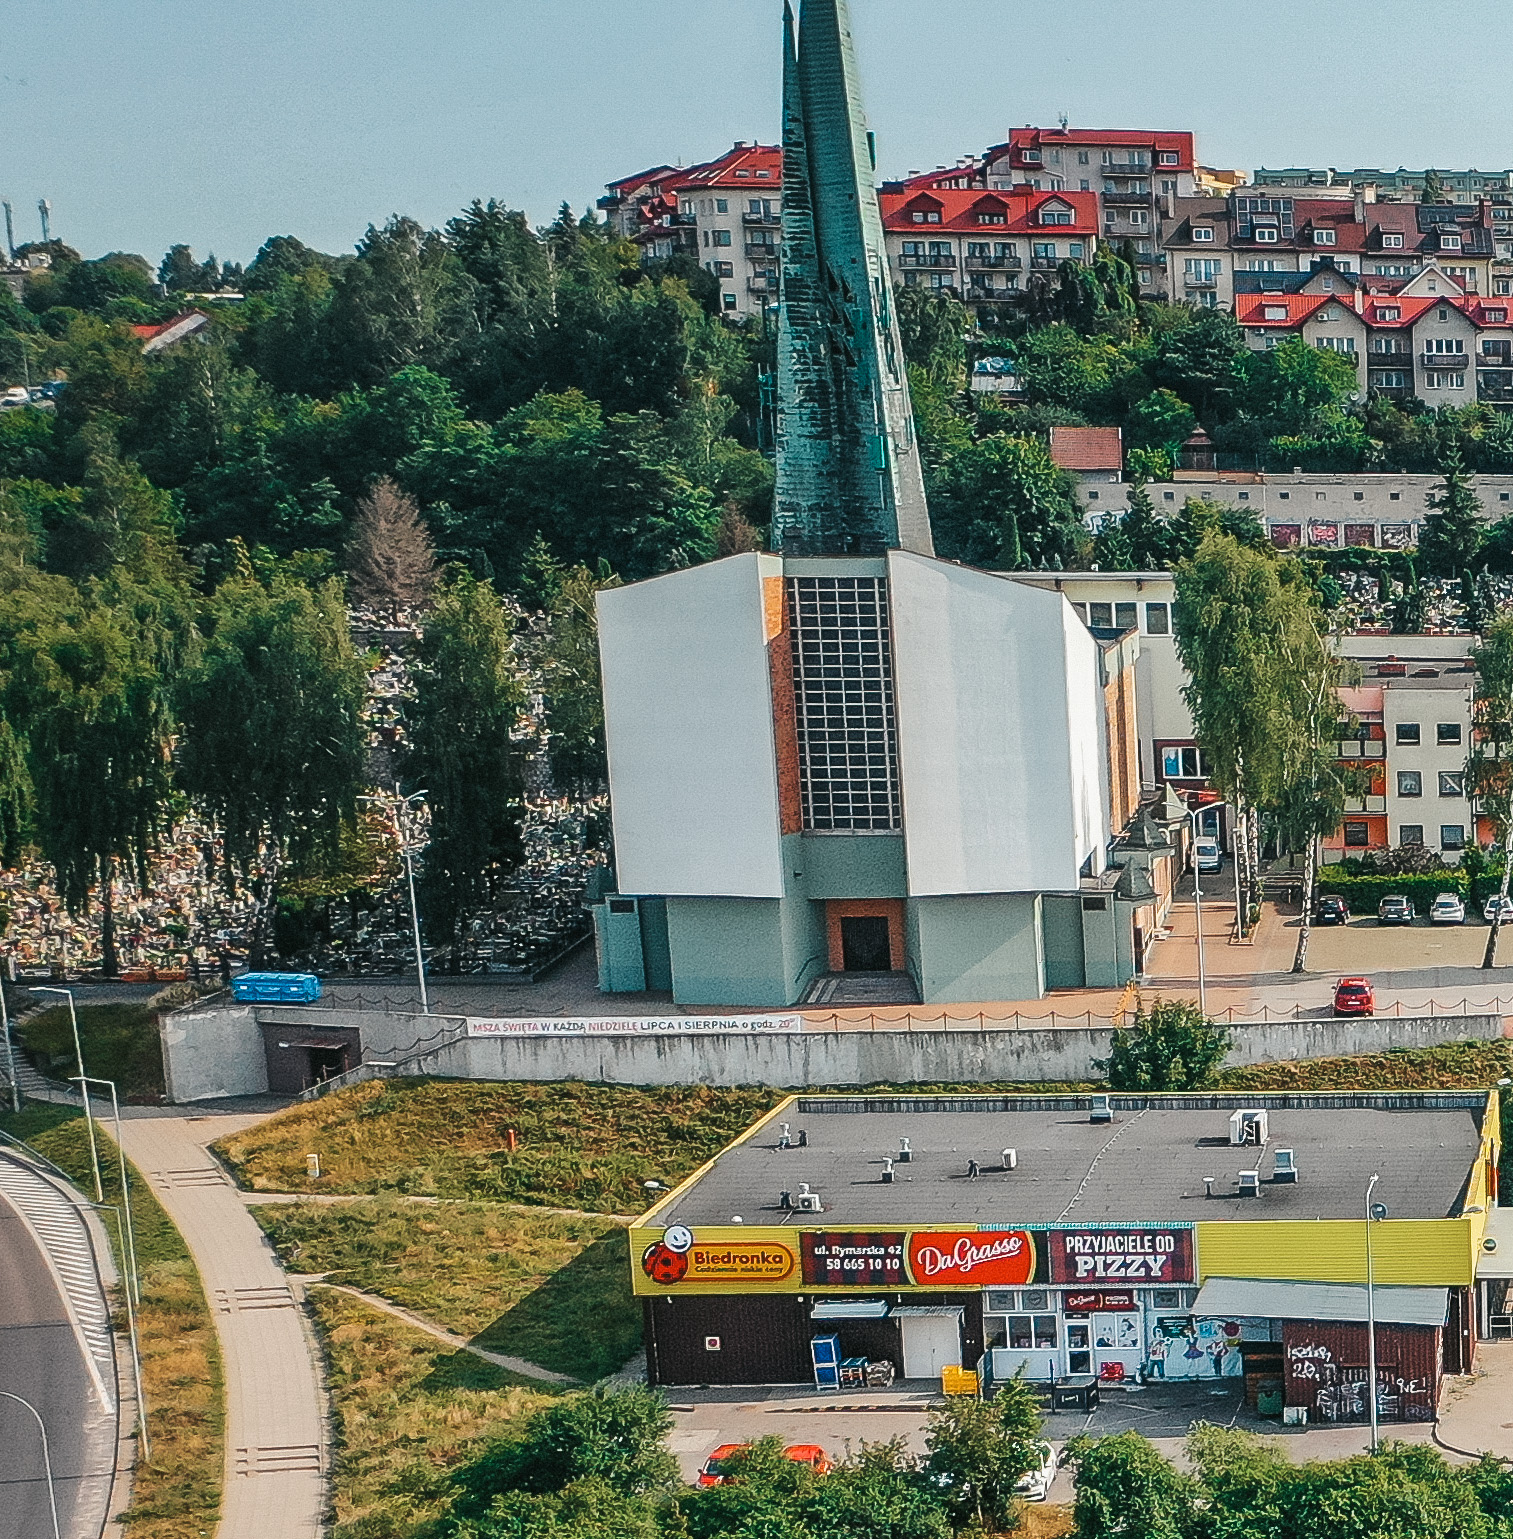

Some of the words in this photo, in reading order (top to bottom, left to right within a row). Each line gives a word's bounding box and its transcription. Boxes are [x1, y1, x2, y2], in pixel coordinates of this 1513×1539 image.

[473, 1023, 500, 1032] MSZA
[502, 1021, 538, 1033] ŚWIĘTA
[541, 1022, 550, 1031] W
[553, 1021, 586, 1033] KAŻDĄ
[588, 1021, 638, 1033] NIEDZIELĘ
[641, 1020, 675, 1031] LIPCA
[684, 1020, 739, 1030] SIERPNIA
[814, 1245, 829, 1255] ul.
[1065, 1235, 1154, 1253] PRZYJACIELE
[1155, 1235, 1175, 1252] OD
[694, 1251, 784, 1265] Biedronka
[826, 1258, 841, 1270] 58
[843, 1258, 865, 1270] 665
[868, 1258, 882, 1270] 10
[885, 1258, 900, 1270] 10
[1075, 1255, 1167, 1277] PIZZY
